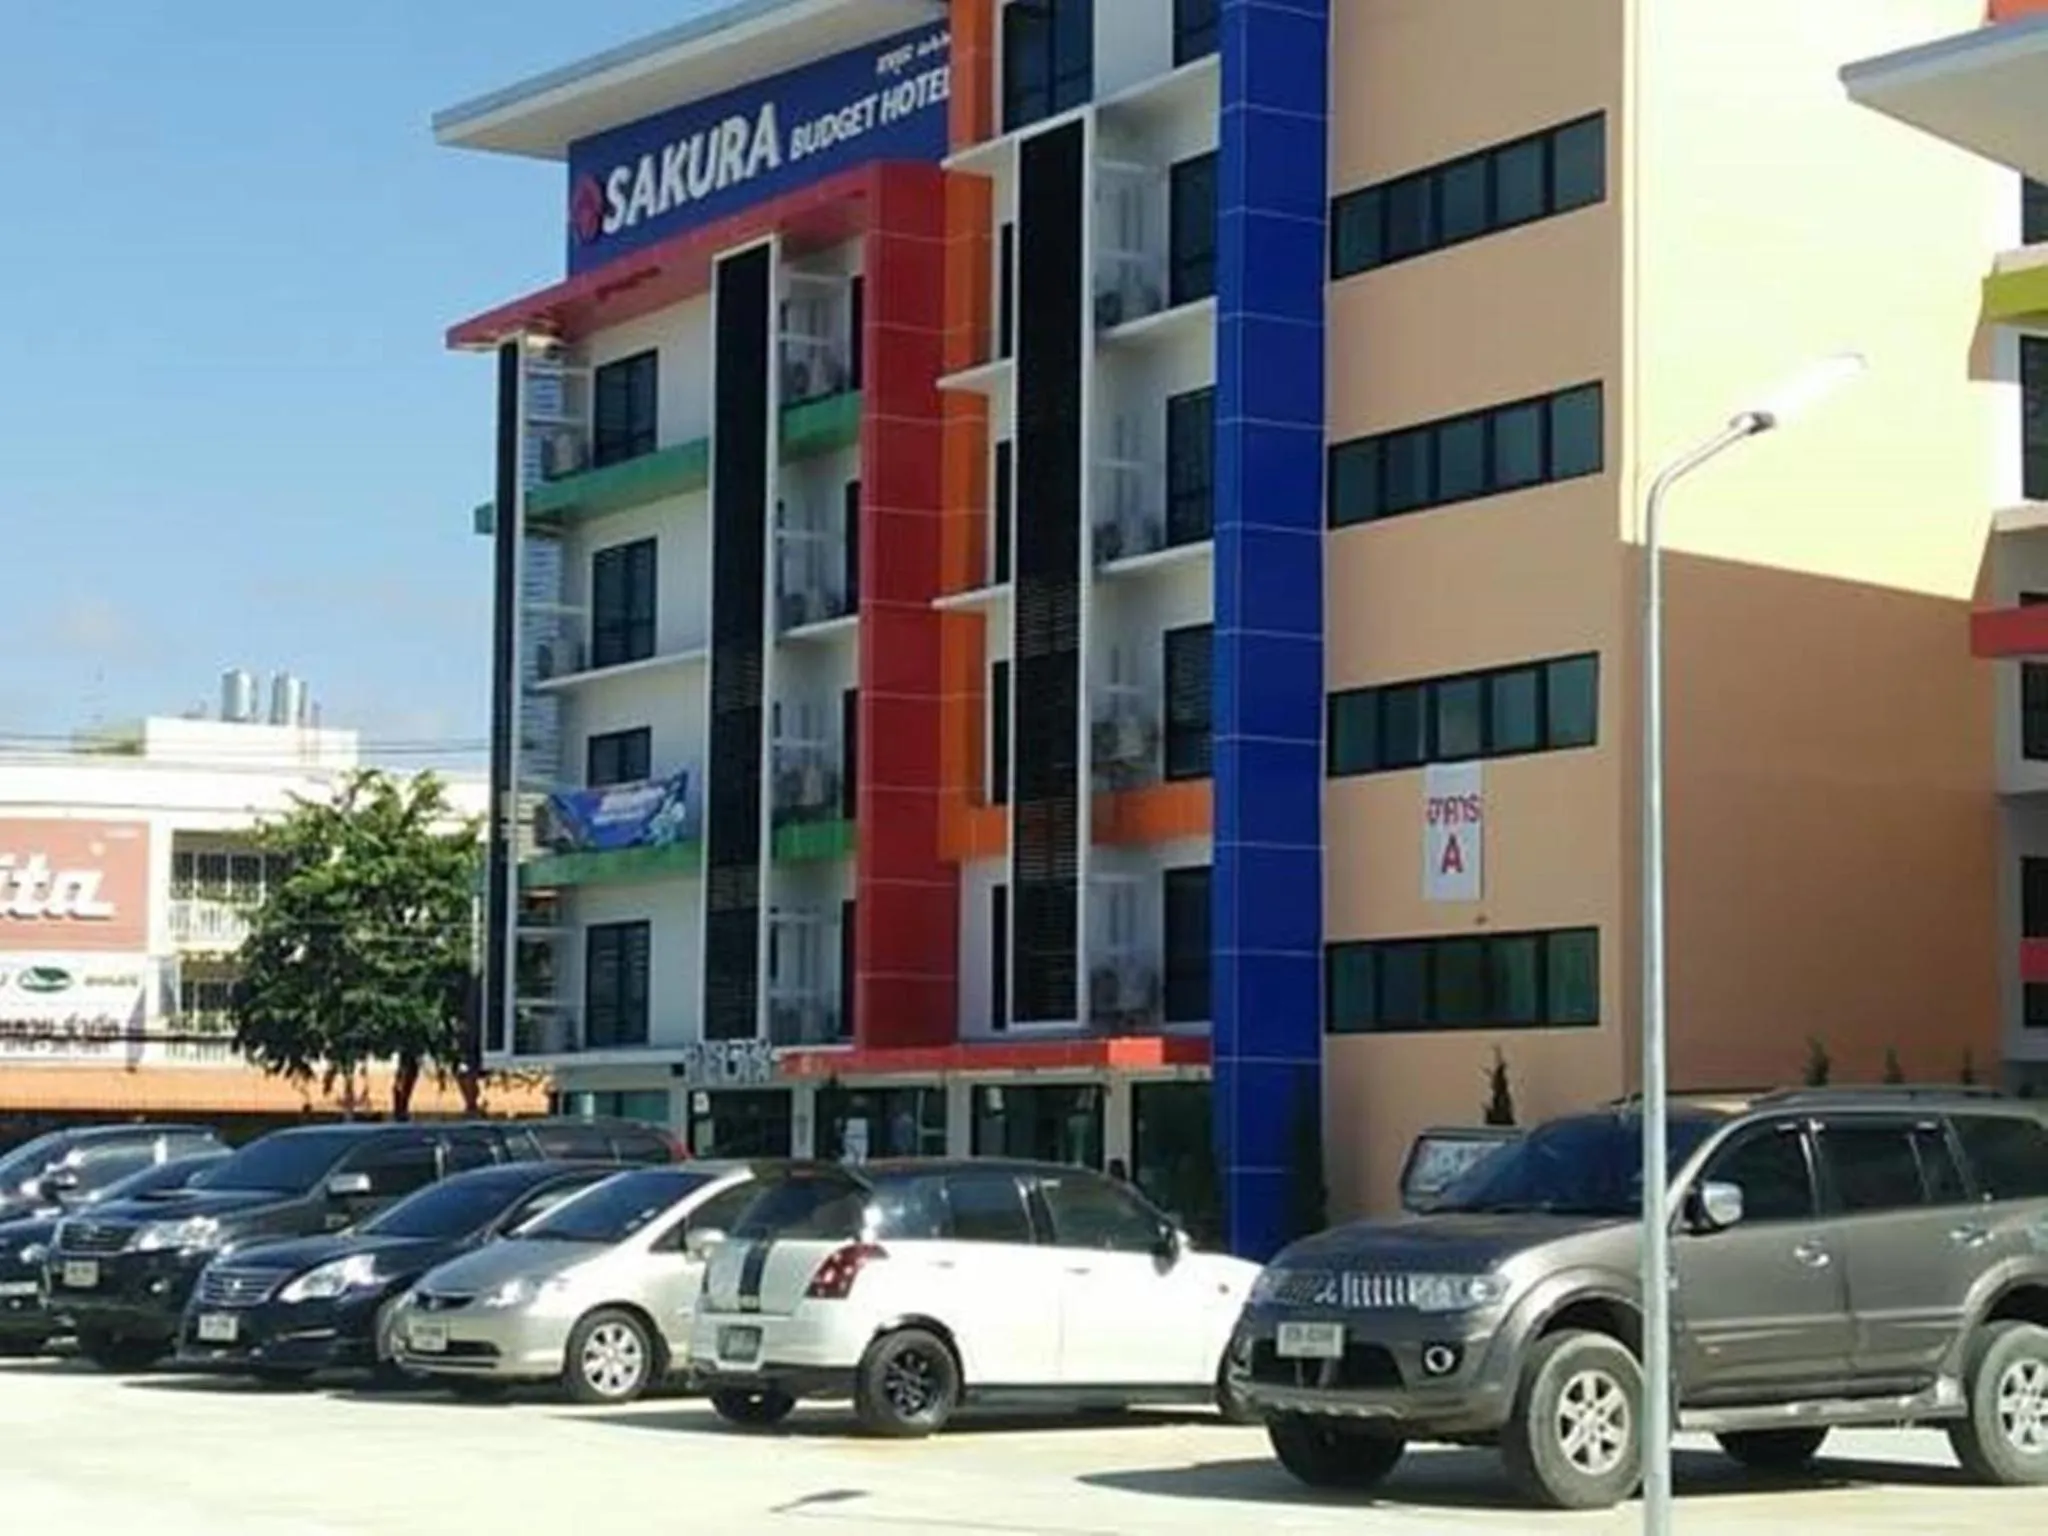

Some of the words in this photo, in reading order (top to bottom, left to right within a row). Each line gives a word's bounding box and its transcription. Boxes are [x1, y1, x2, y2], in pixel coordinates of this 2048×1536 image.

[603, 101, 781, 234] SAKURA
[791, 94, 878, 161] BUDGET
[1441, 834, 1463, 874] A
